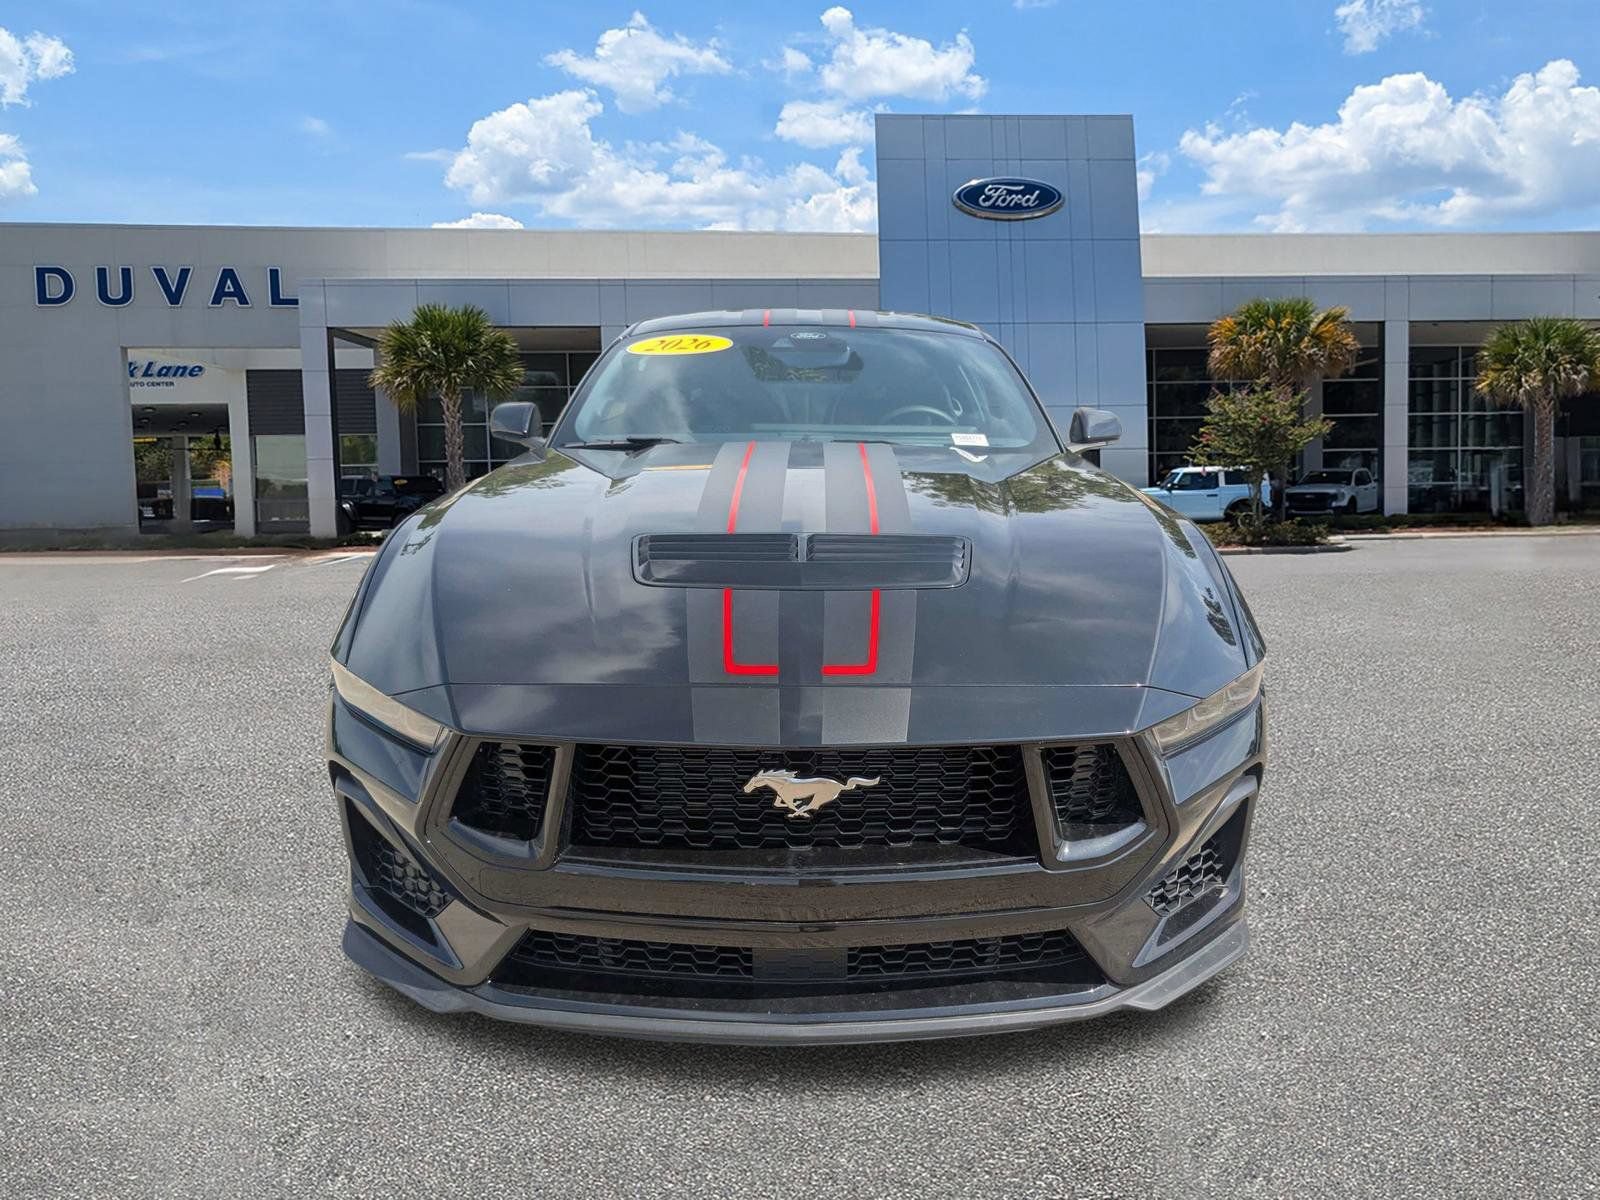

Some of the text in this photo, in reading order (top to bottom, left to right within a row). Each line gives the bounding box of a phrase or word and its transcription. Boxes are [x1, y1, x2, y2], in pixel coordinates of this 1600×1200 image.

[979, 184, 1040, 207] Ford
[34, 265, 299, 308] DUVAL
[643, 338, 713, 352] 2026
[141, 361, 205, 378] Lane
